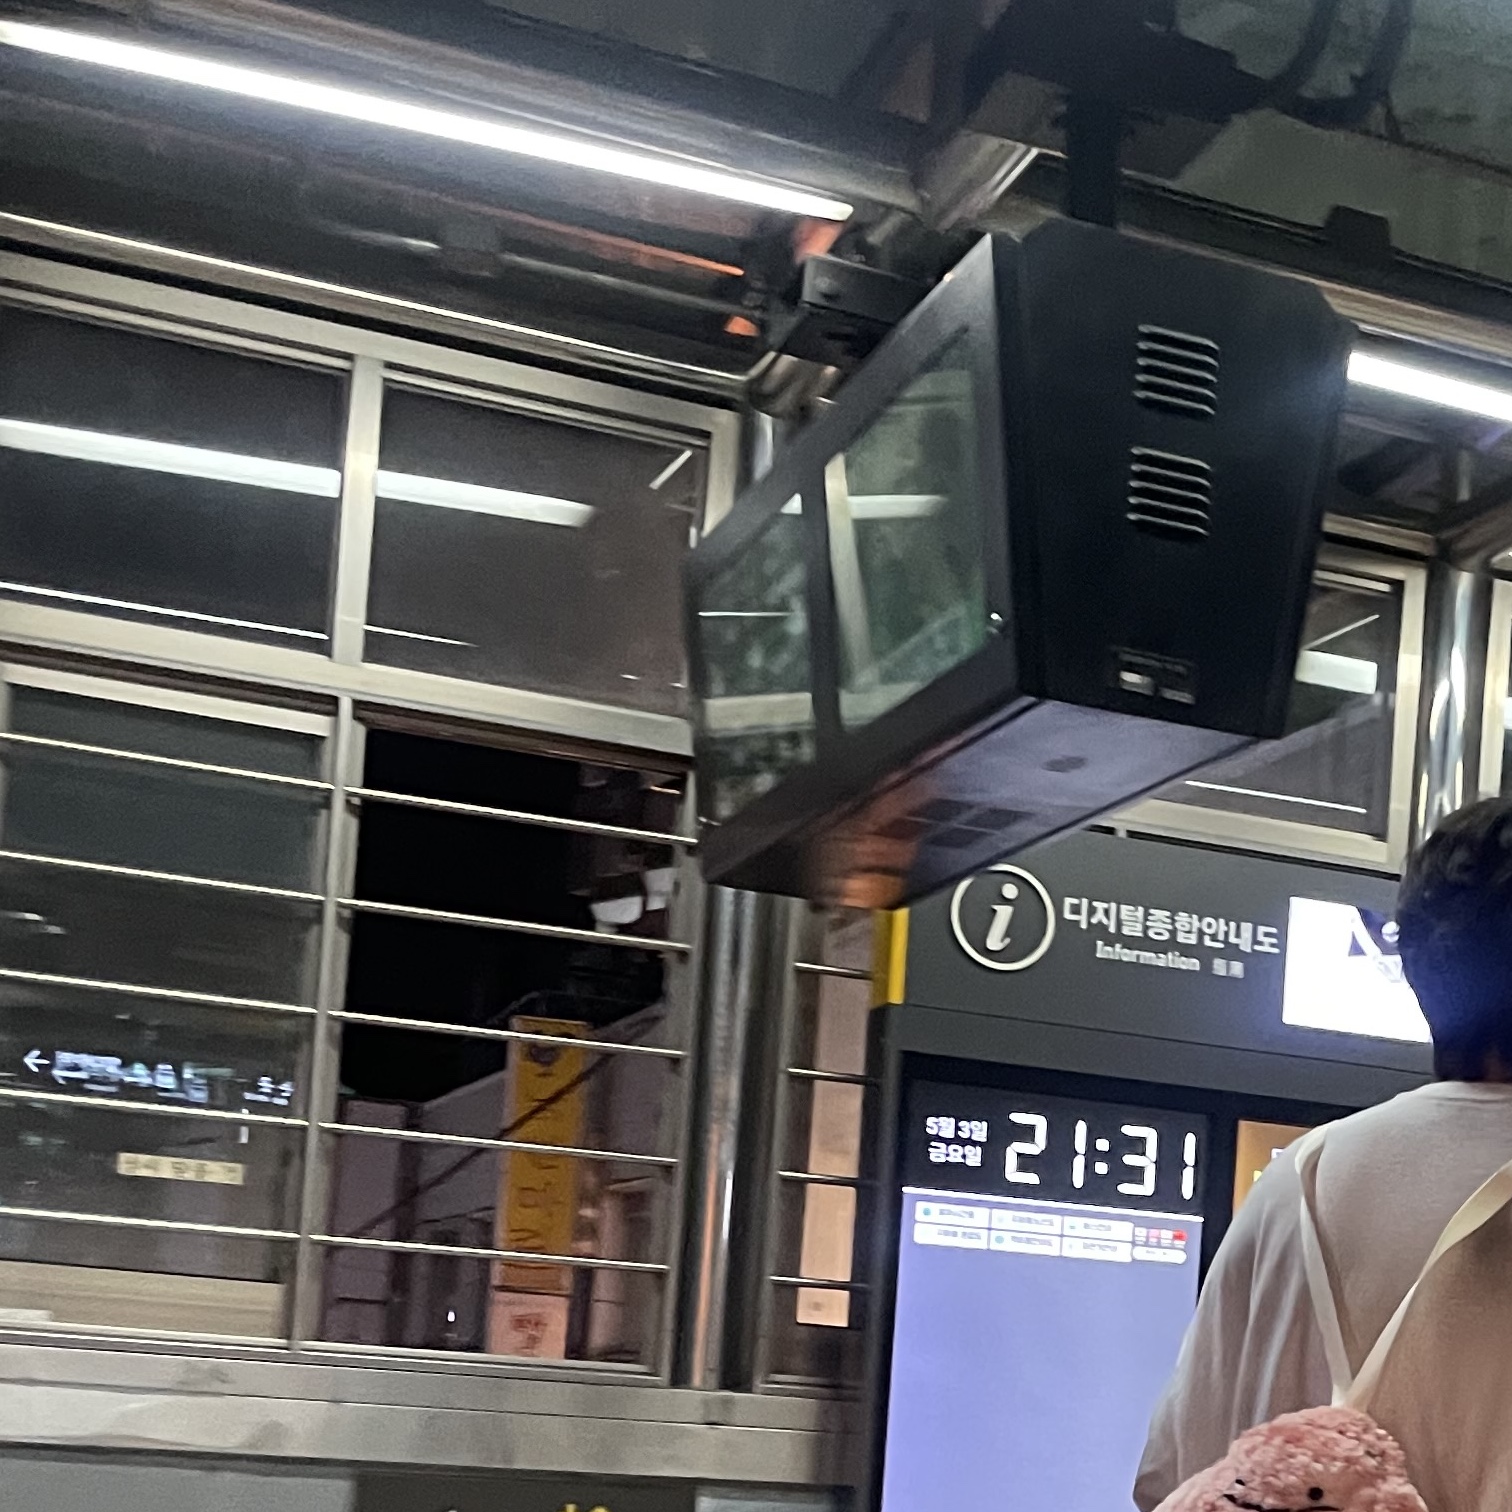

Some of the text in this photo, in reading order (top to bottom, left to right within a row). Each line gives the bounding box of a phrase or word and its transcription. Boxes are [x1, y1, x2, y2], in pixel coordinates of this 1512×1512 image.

[1062, 896, 1280, 955] 디지털종합안내도
[1095, 939, 1200, 971] Information
[925, 1116, 988, 1142] 5월 3일
[927, 1141, 982, 1167] 금요일
[1003, 1111, 1197, 1200] 21:31
